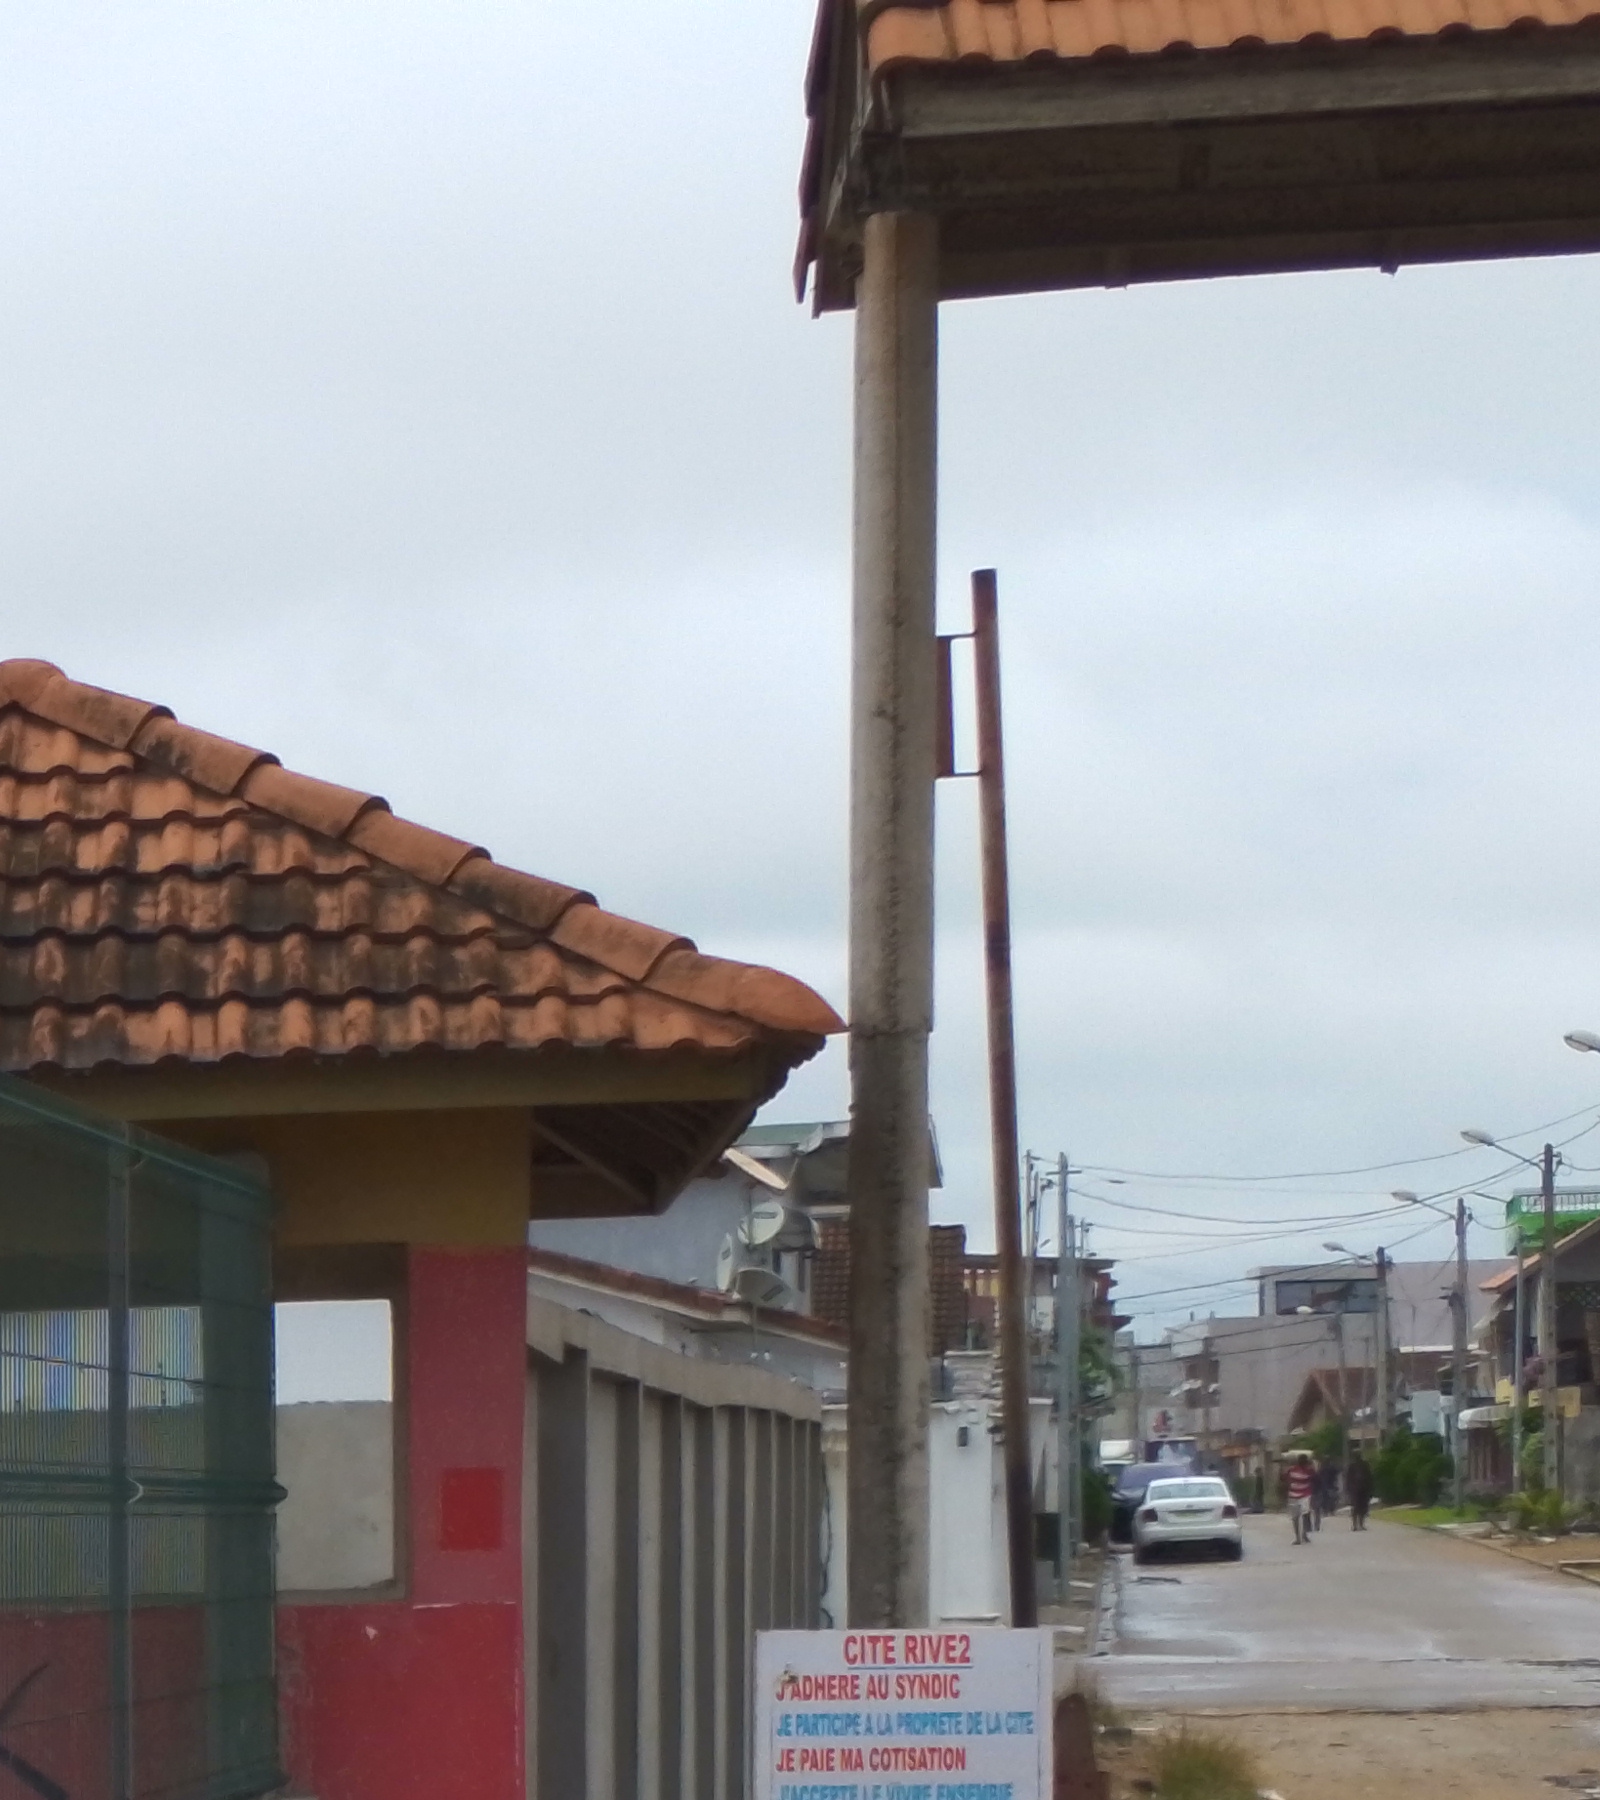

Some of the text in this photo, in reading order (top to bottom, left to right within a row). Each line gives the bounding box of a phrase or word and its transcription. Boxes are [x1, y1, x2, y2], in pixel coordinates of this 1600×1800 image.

[843, 1633, 971, 1665] CITE RIVE2
[776, 1673, 961, 1701] JADHERE AU SYNDIC
[777, 1713, 792, 1736] JE
[776, 1746, 967, 1772] JE PAIE MA COTISATION
